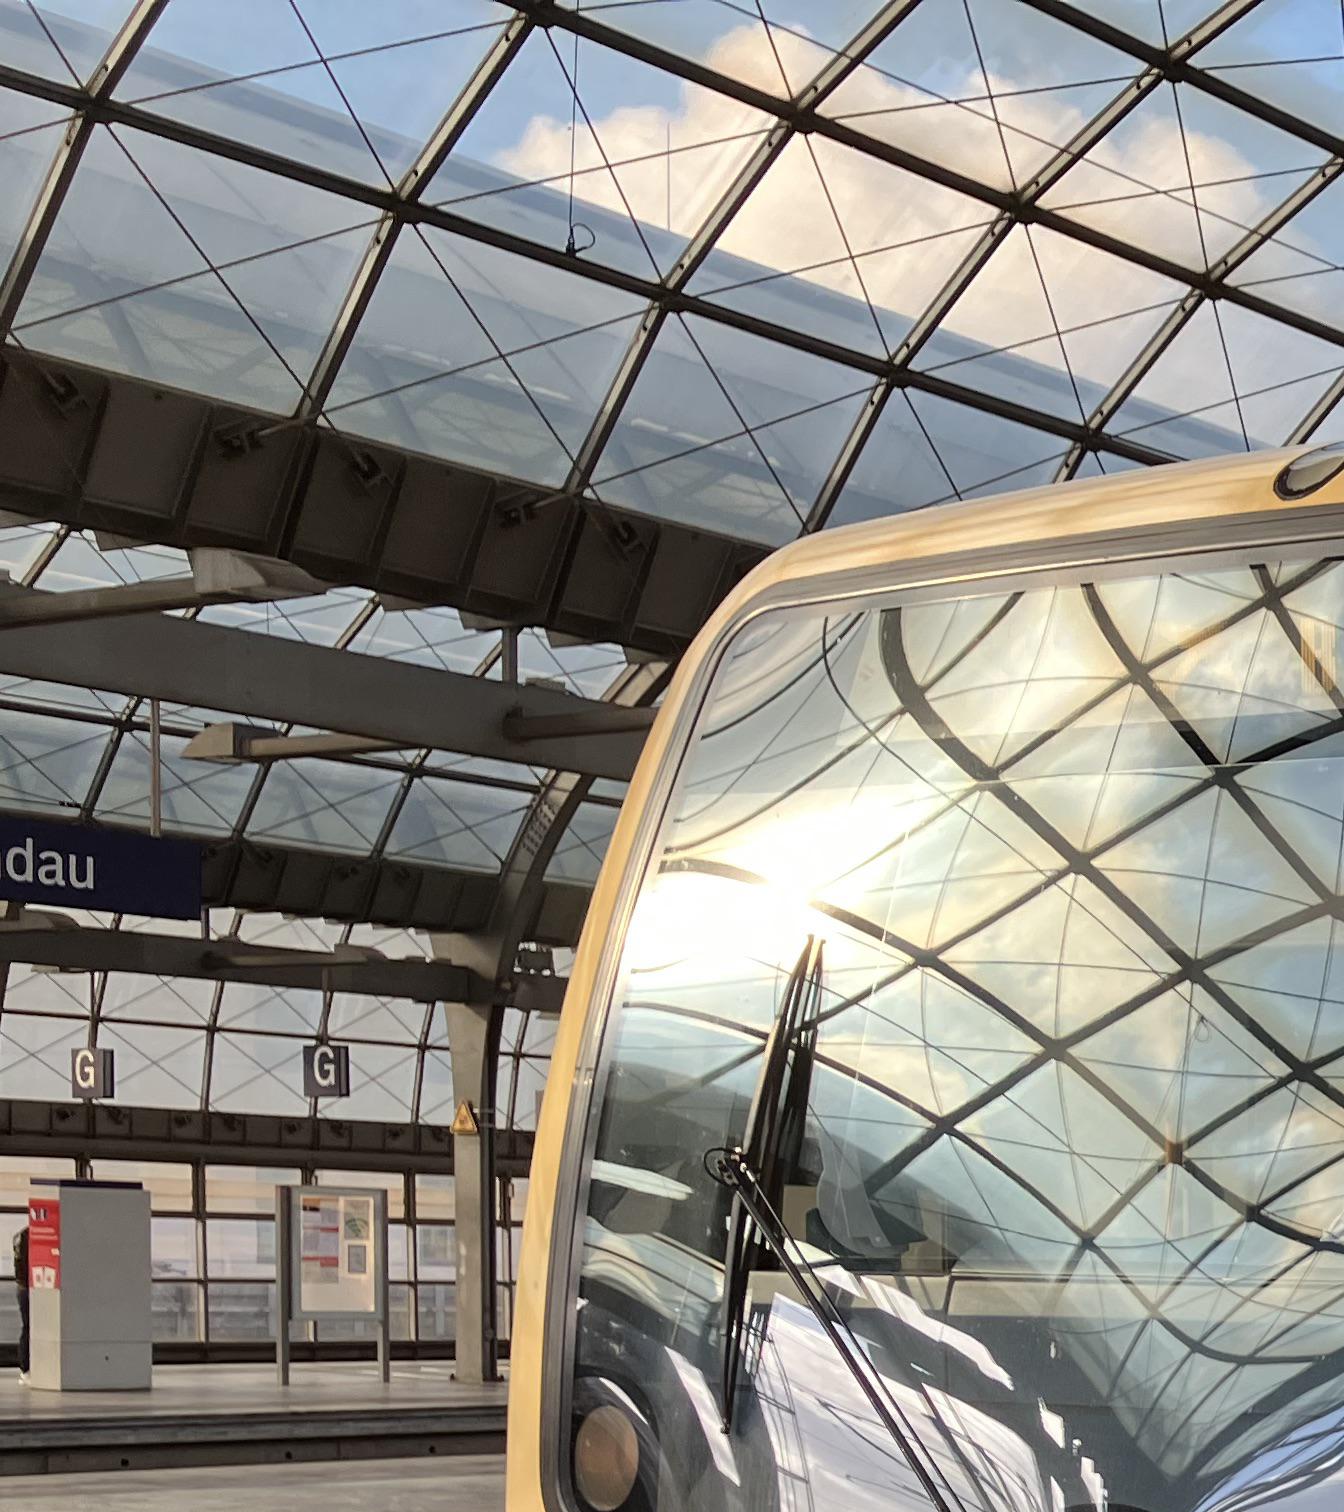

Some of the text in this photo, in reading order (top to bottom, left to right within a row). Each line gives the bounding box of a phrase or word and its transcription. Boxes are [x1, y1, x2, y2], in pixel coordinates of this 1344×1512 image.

[0, 837, 95, 890] dau
[75, 1049, 95, 1089] G
[313, 1045, 336, 1087] G
